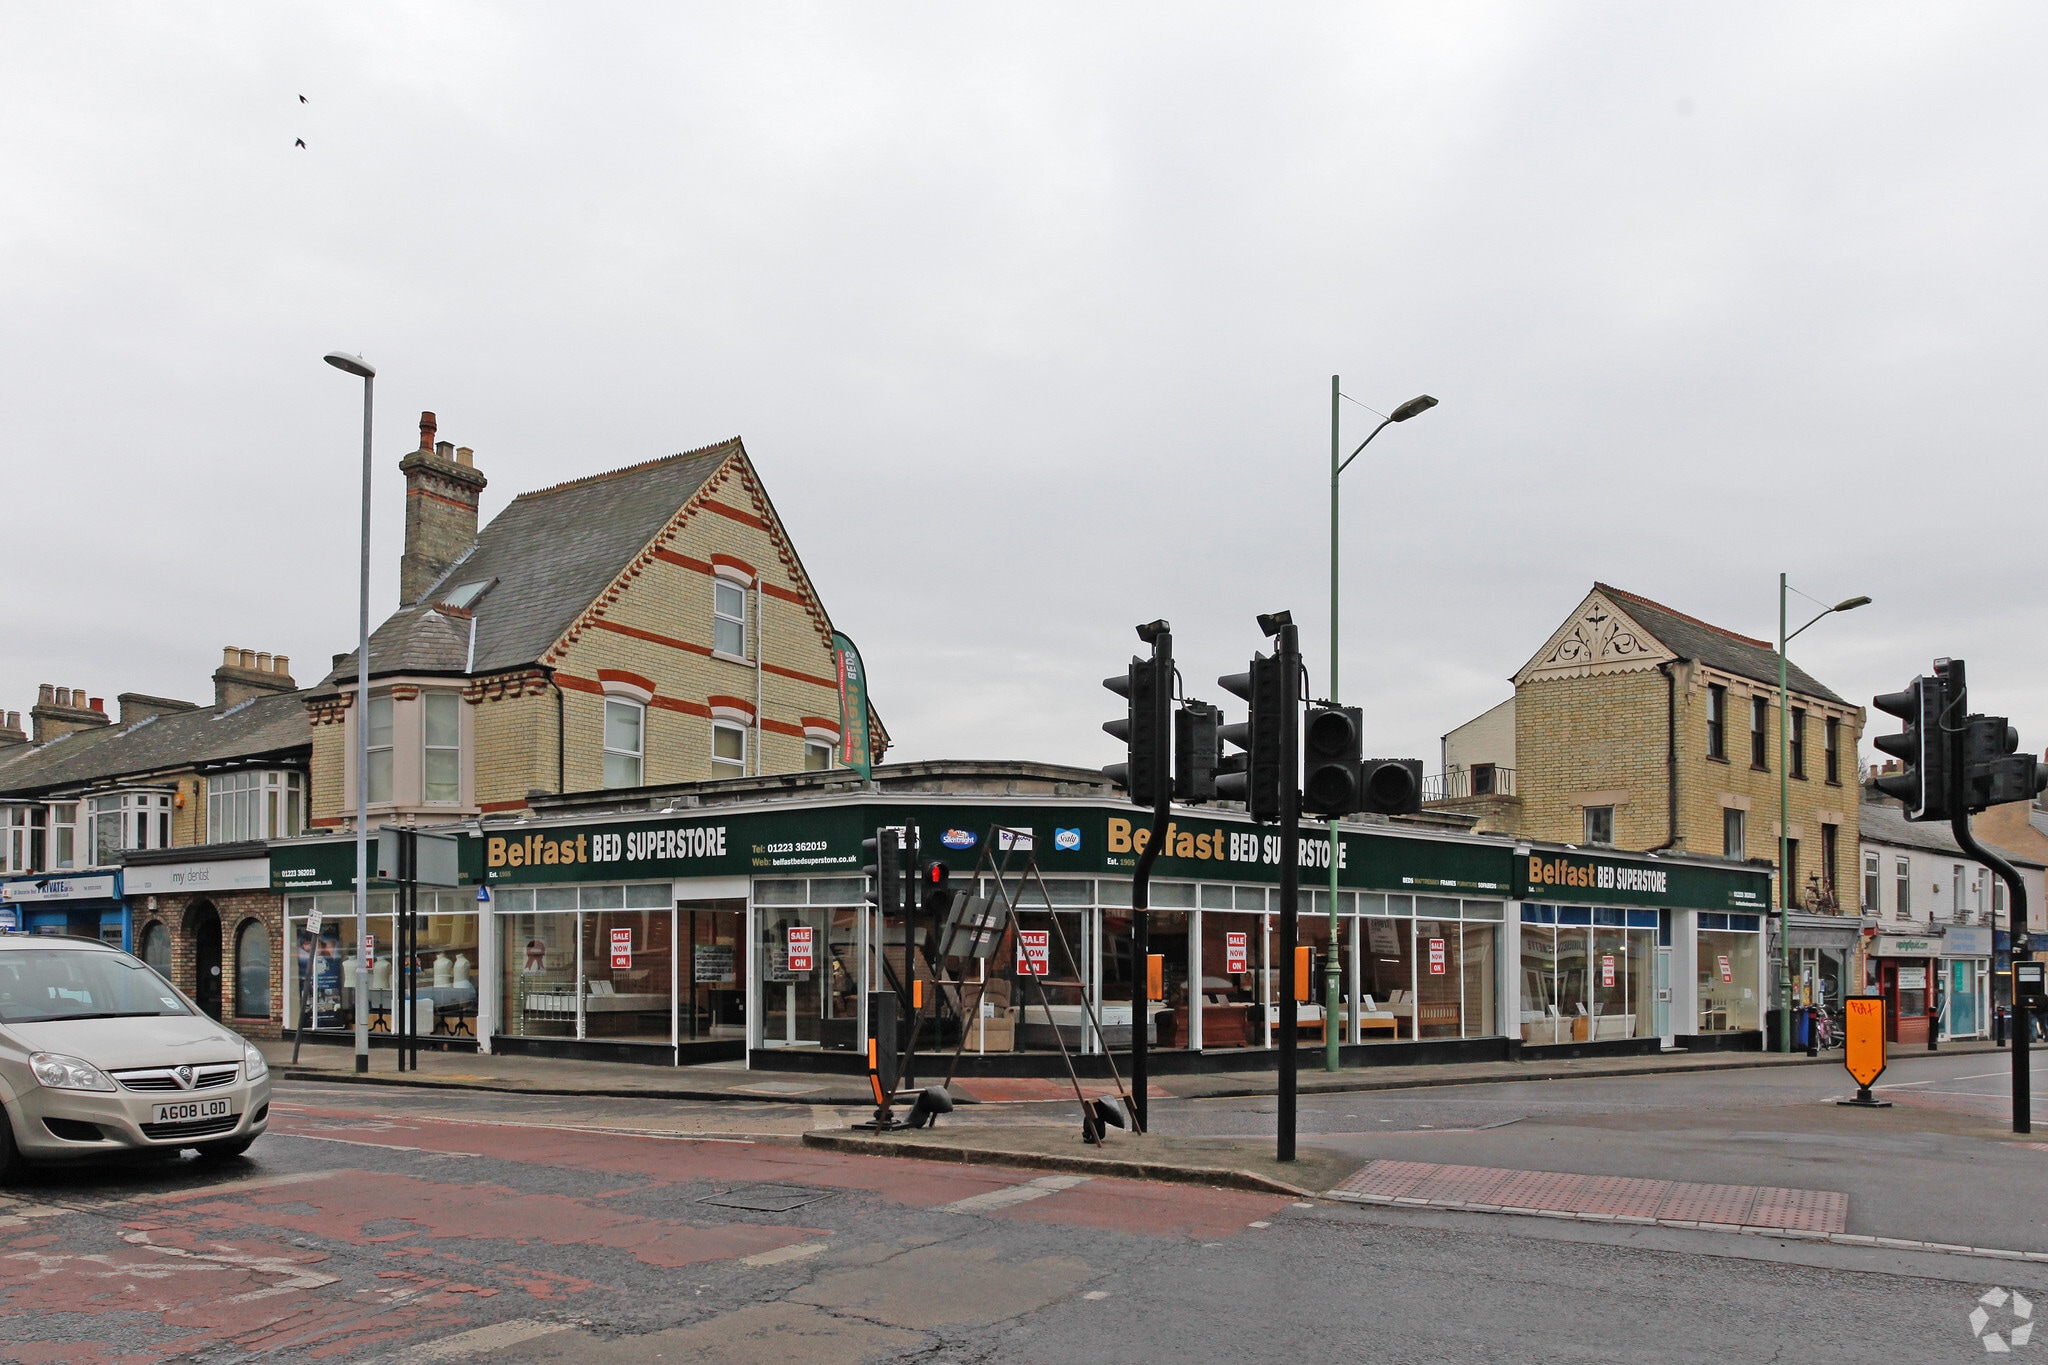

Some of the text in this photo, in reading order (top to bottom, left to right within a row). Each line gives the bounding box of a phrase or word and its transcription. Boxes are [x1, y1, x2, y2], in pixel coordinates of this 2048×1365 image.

[1058, 833, 1077, 845] Sealy
[1108, 818, 1346, 868] Befast BED SURSTOE
[488, 827, 726, 867] Belfast BED SUPERSTORE
[752, 841, 827, 853] Tel: 01223 362019
[752, 855, 856, 866] Web: belfastbedsuperstore.co.uk
[1107, 857, 1135, 866] Est. 1905
[172, 868, 210, 885] my dentist
[1529, 856, 1666, 893] Belfast BED SUPERSTORE
[613, 932, 629, 940] SALE
[1022, 935, 1046, 944] SALE
[795, 959, 806, 967] ON
[1232, 962, 1241, 970] ON
[160, 1101, 226, 1120] AG08 LOD
